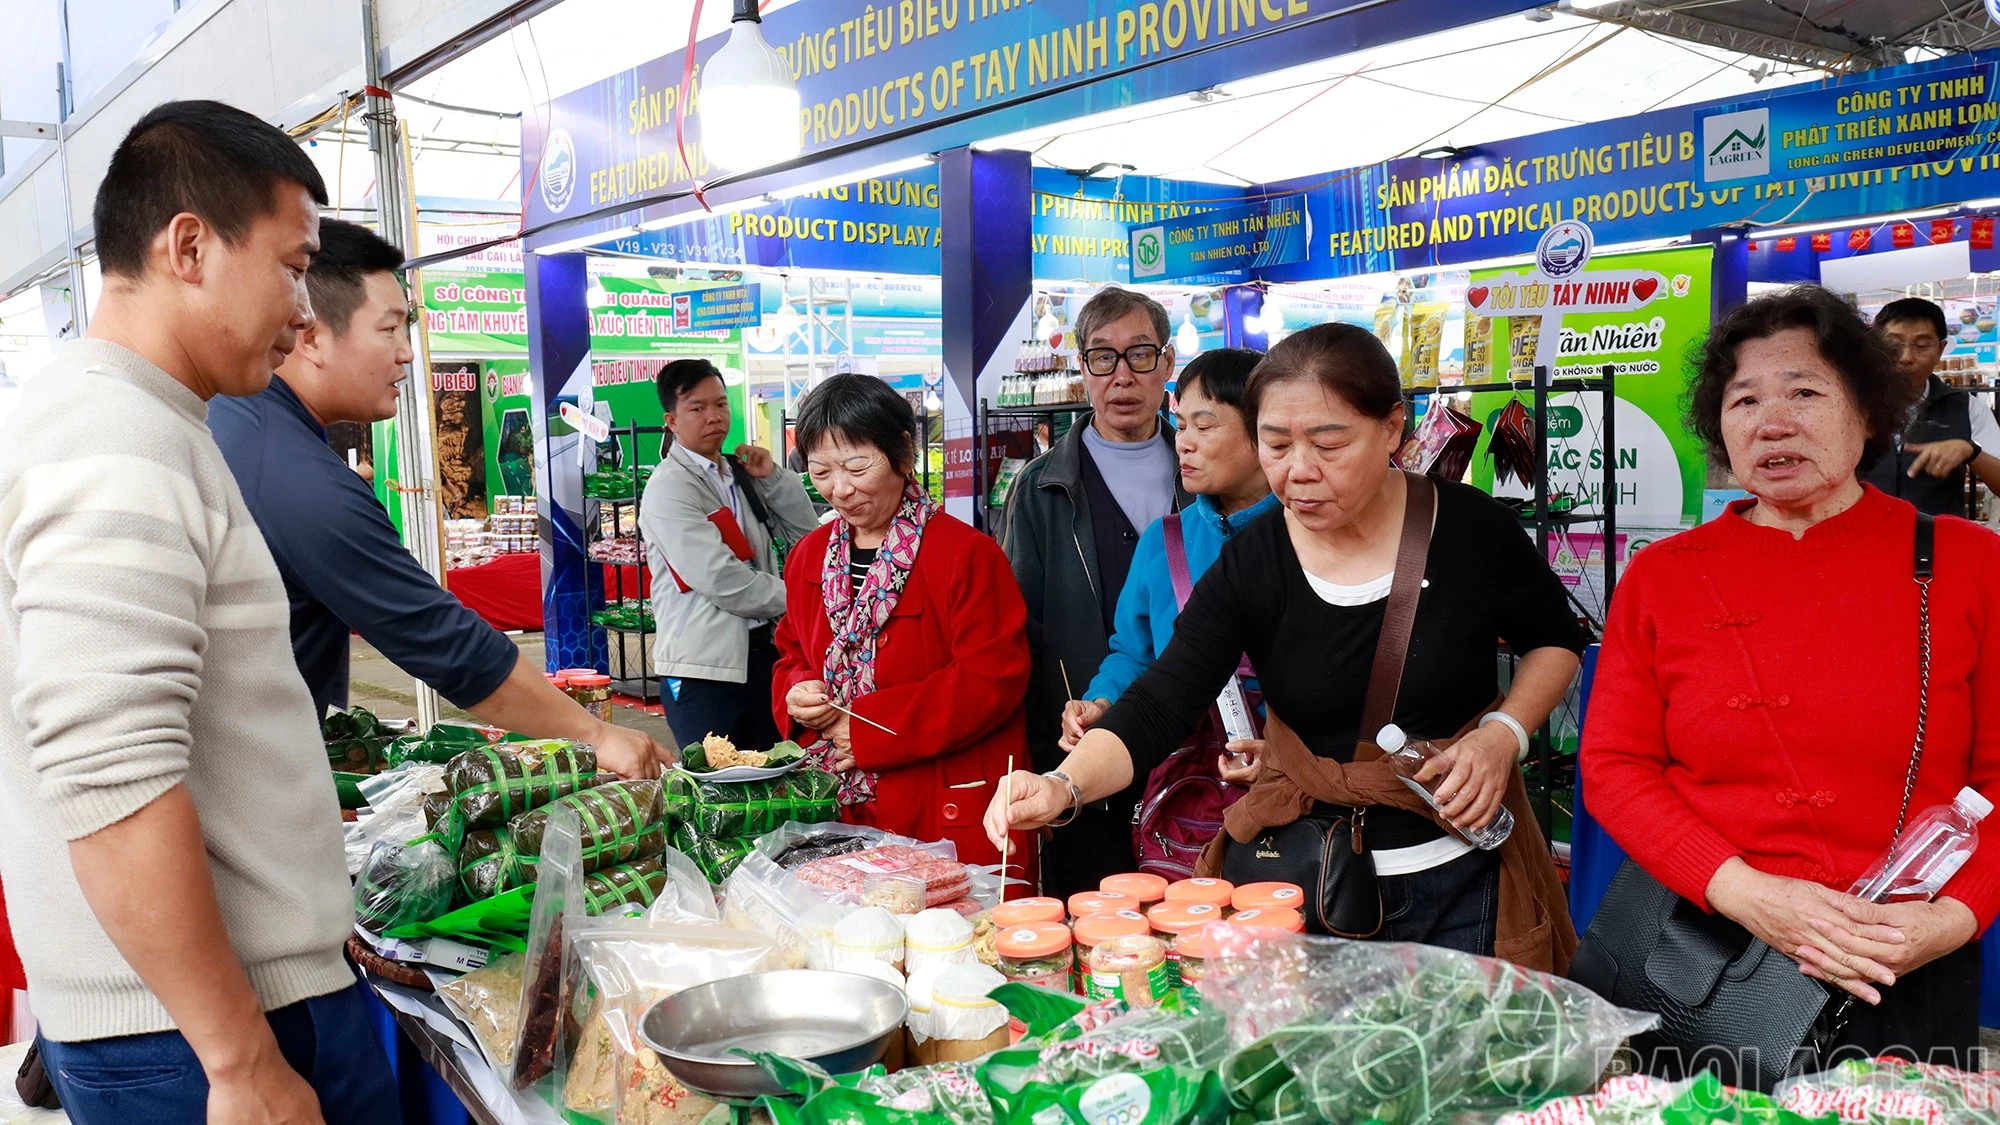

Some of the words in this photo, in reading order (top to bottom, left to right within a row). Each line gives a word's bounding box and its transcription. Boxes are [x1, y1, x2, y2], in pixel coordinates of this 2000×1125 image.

[628, 85, 661, 136] SẢN
[840, 4, 893, 64] TIÊU
[1836, 91, 1892, 115] CÔNG
[1896, 84, 1923, 106] TY
[1926, 75, 1985, 101] TNHH
[589, 151, 670, 206] FEATURED
[800, 71, 925, 149] PRODUCTS
[930, 59, 965, 112] OF
[969, 42, 1021, 101] TAY
[1028, 16, 1108, 87] NINH
[1782, 124, 1830, 149] PHÁT
[1834, 112, 1891, 141] TRIỂN
[1896, 107, 1953, 133] XANH
[1957, 101, 2000, 125] LON
[1709, 150, 1763, 166] LAGREEN
[1787, 154, 1820, 170] LONG
[1822, 151, 1840, 165] AN
[1843, 146, 1884, 162] GREEN
[1887, 133, 1984, 157] DEVELOPMENT
[1376, 174, 1415, 211] SẢN
[1419, 162, 1481, 203] PHẨM
[1483, 156, 1529, 198] ĐẶC
[1531, 145, 1613, 185] TRƯNG
[1616, 131, 1673, 171] TIÊU
[857, 178, 940, 209] TRƯNG
[729, 210, 839, 242] PRODUCT
[842, 220, 930, 248] DISPLAY
[1168, 225, 1195, 246] CÔNG
[1196, 226, 1210, 241] TY
[1211, 219, 1240, 238] TNHH
[1242, 213, 1264, 233] TÂN
[1266, 207, 1301, 229] NHIÊN
[1329, 221, 1425, 258] FEATURED
[1428, 214, 1474, 245] AND
[1475, 200, 1562, 238] TYPICAL
[1572, 181, 1706, 224] PRODUCTS
[437, 232, 454, 247] HỘI
[615, 239, 640, 254] V19
[651, 242, 675, 256] V23
[686, 244, 708, 258] V31
[720, 246, 742, 260] V34
[1052, 234, 1098, 257] NINH
[1190, 250, 1206, 263] TAN
[1207, 247, 1233, 260] NHIEN
[1252, 241, 1270, 254] LTD
[436, 284, 459, 300] SỞ
[464, 286, 509, 302] CÔNG
[1490, 282, 1517, 310] TÔI
[1519, 279, 1549, 309] YÊU
[1553, 279, 1583, 306] TÂY
[1584, 281, 1631, 305] NINH
[449, 309, 479, 332] TÂM
[483, 309, 526, 332] KHUYẾ
[598, 311, 624, 334] XÚC
[626, 310, 654, 335] TIẾN
[1560, 331, 1588, 353] ân
[1591, 326, 1658, 352] Nhiên
[444, 366, 476, 391] BIỂU
[1562, 365, 1594, 376] KHÔNG
[1629, 361, 1658, 372] NƯỚC
[1548, 444, 1581, 476] ẶC
[1589, 447, 1637, 470] SN
